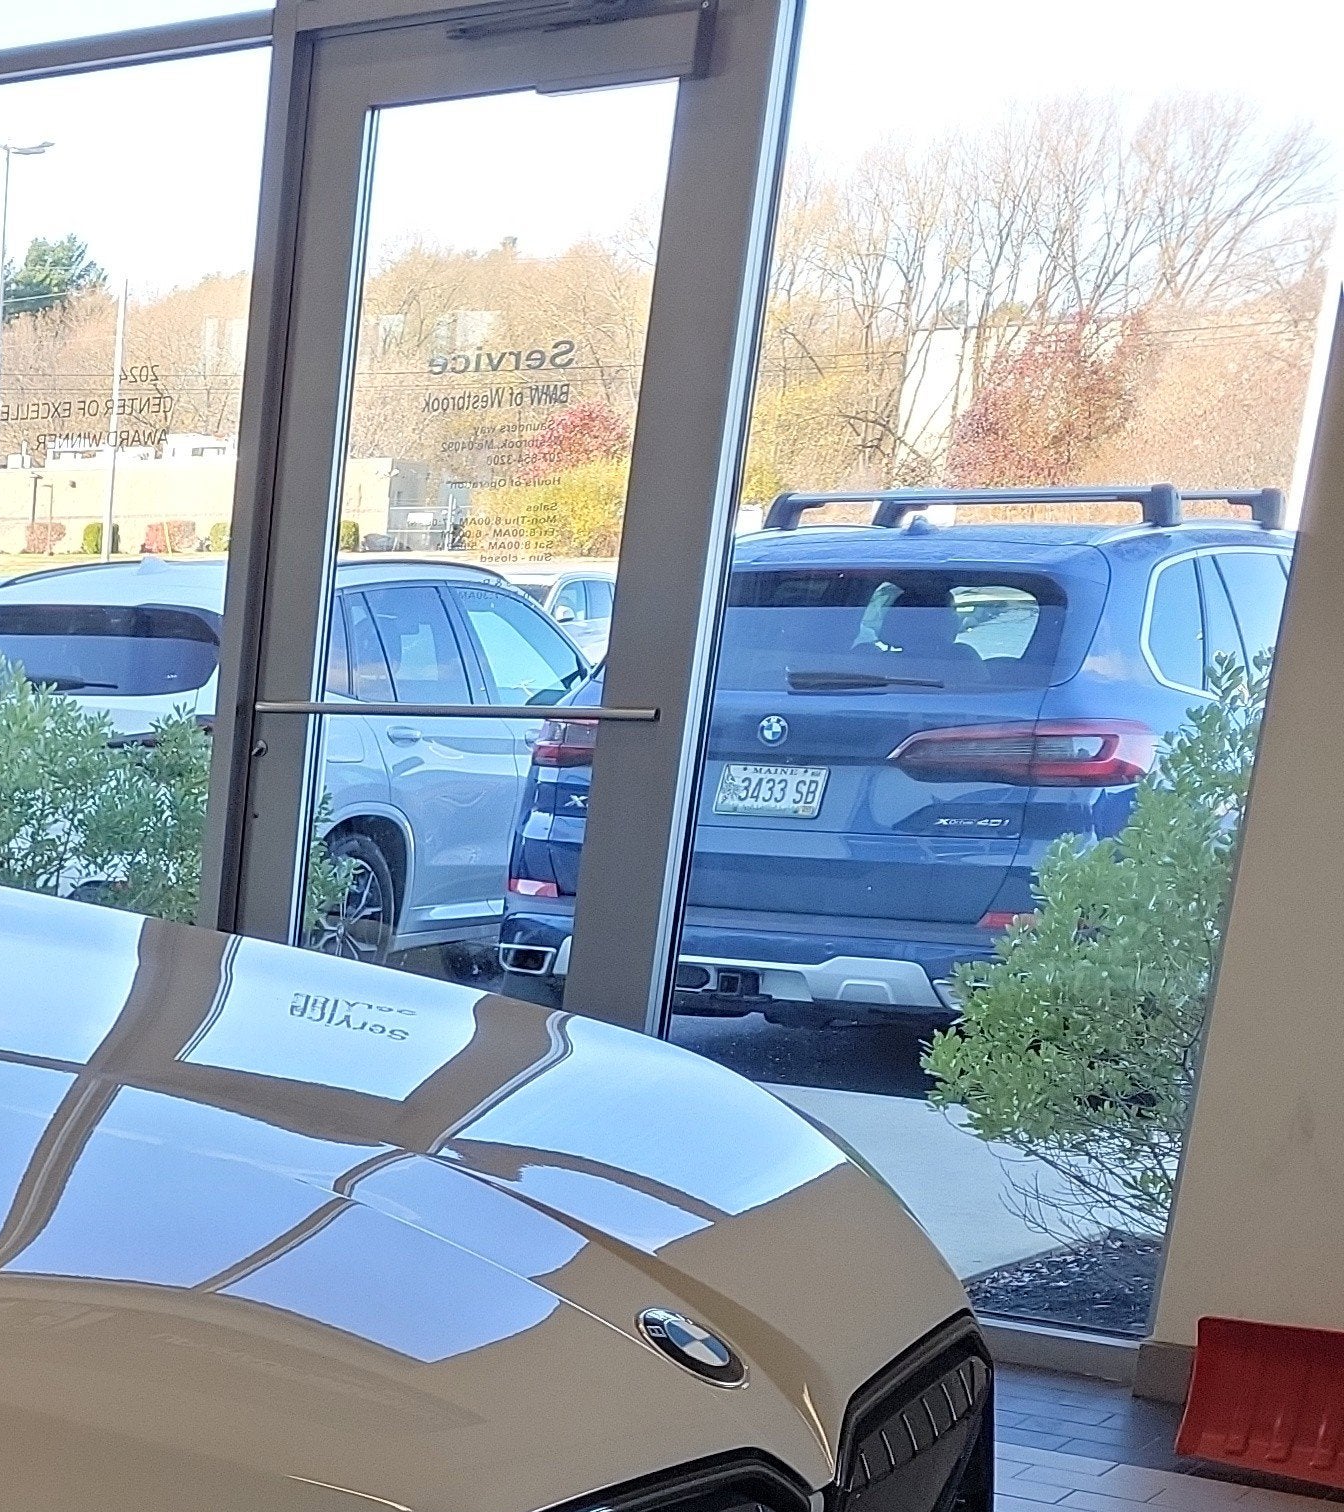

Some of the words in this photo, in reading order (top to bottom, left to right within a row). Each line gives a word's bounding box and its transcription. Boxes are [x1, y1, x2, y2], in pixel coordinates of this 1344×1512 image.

[752, 767, 799, 776] MAINE
[737, 777, 789, 804] 3433
[792, 779, 820, 805] SB
